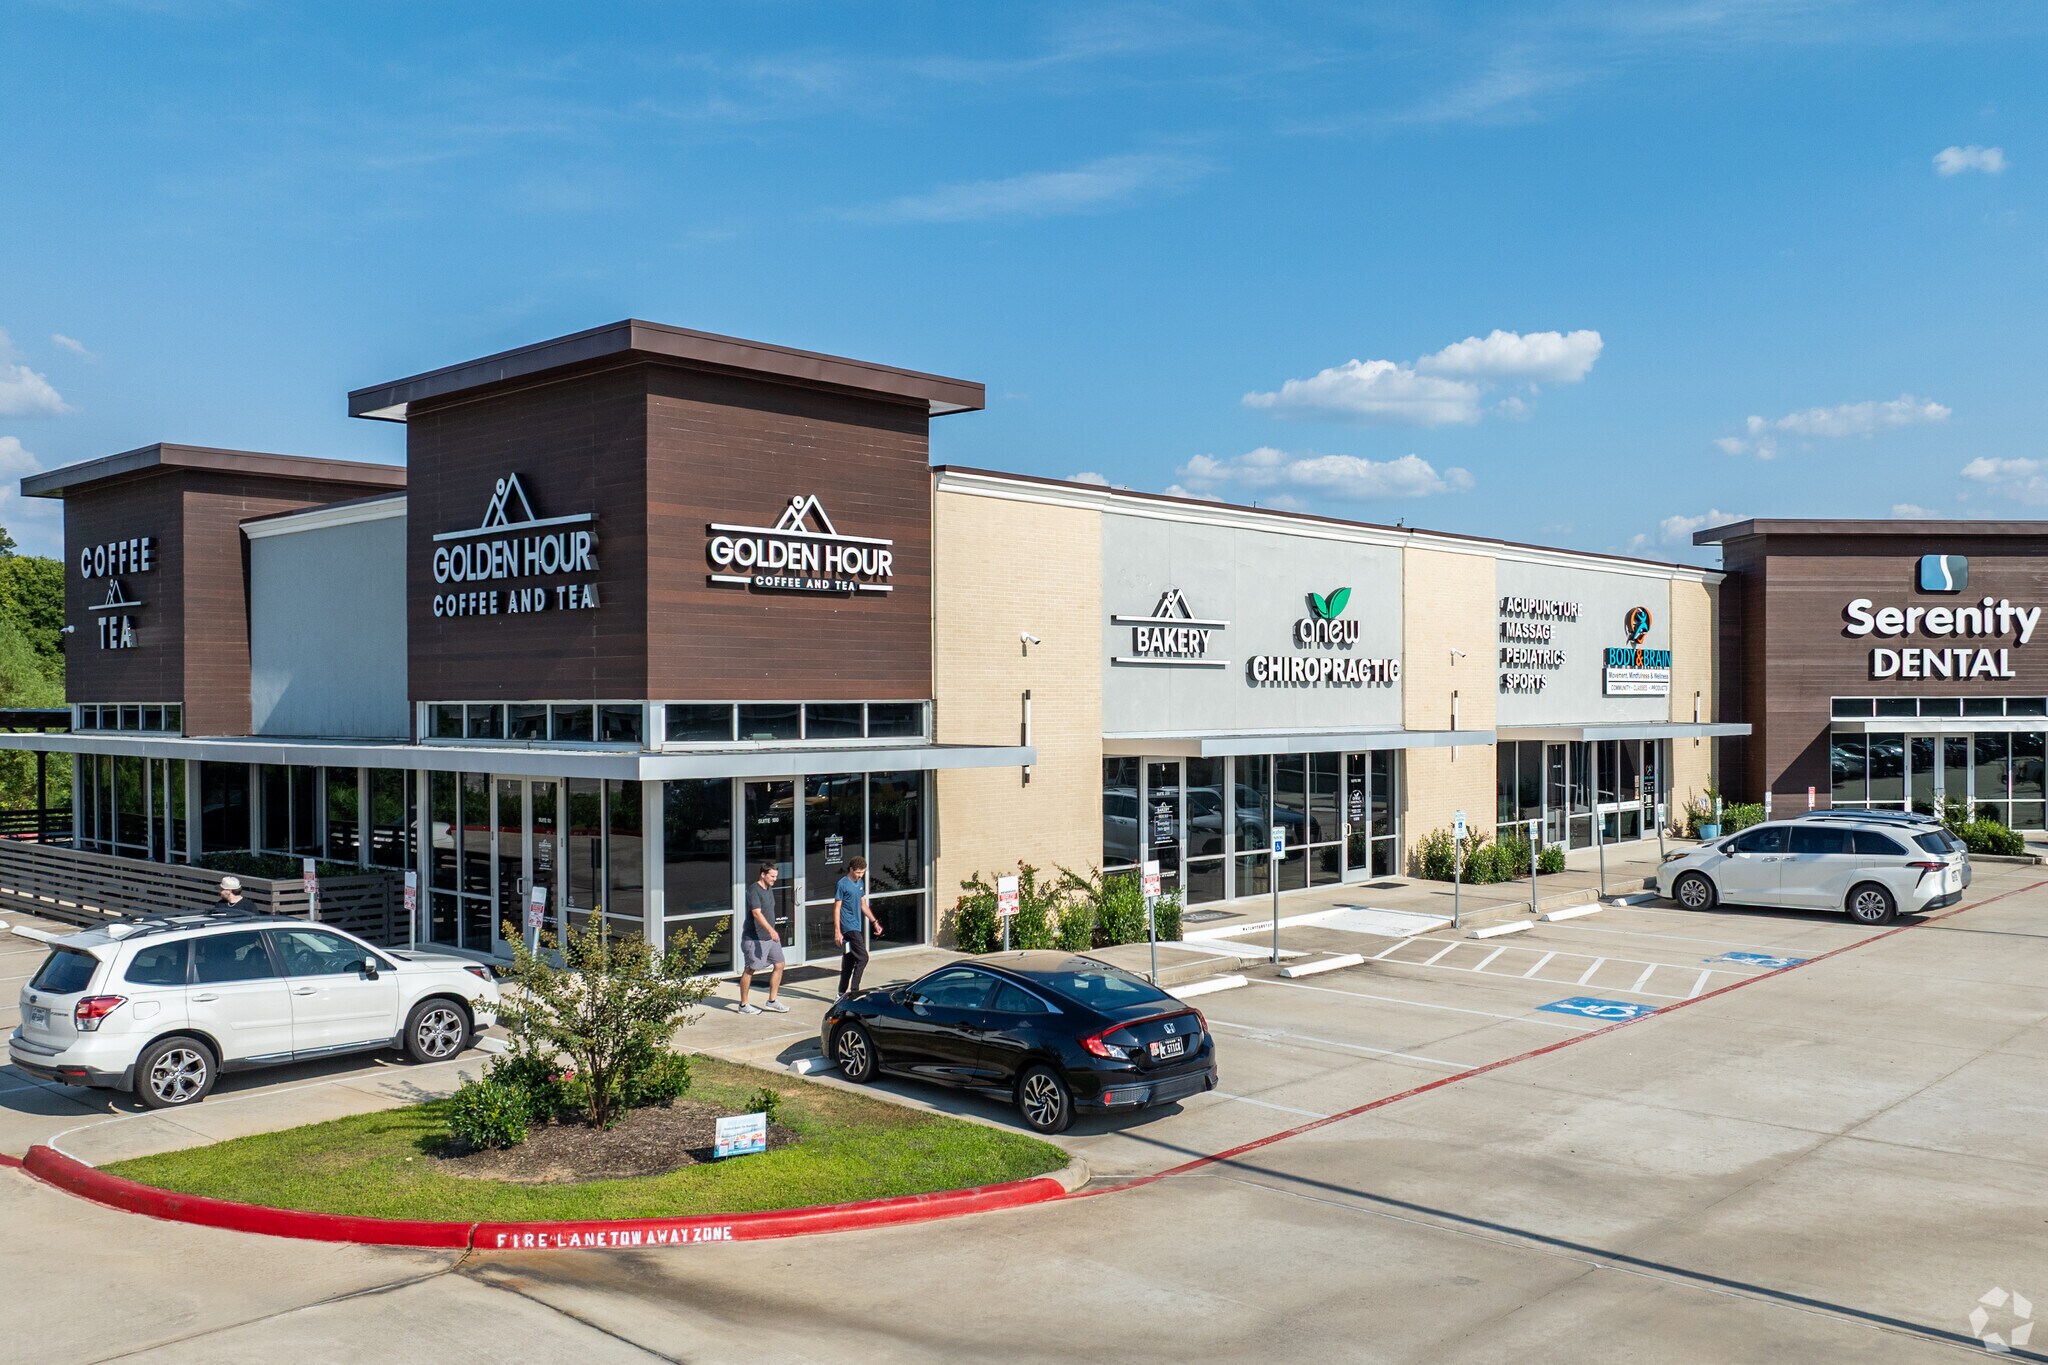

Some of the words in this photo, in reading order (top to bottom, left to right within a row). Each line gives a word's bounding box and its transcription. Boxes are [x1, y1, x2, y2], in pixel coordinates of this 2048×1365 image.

[81, 537, 149, 579] COFFEE
[433, 539, 518, 584] GOLDEN
[524, 531, 592, 576] HOUR
[711, 536, 819, 571] GOLDEN
[825, 545, 893, 577] HOUR
[755, 575, 801, 588] COFFEE
[806, 579, 829, 590] AND
[835, 580, 856, 591] TEA
[433, 590, 498, 618] COFFEE
[508, 587, 546, 614] AND
[556, 584, 594, 610] TEA
[1507, 597, 1583, 617] ACUPUNCTURE
[98, 615, 132, 650] TEA
[1300, 618, 1361, 644] anew
[1506, 622, 1556, 639] MASSAGE
[1847, 597, 2042, 644] Serenity
[1137, 626, 1212, 653] BAKERY
[1253, 655, 1401, 682] CHIROPRACTIC
[1506, 648, 1567, 665] PEDIATRICS
[1874, 648, 2016, 677] DENTAL
[1506, 673, 1547, 689] SPORTS
[496, 1233, 548, 1248] FIRE
[557, 1232, 606, 1247] LANE
[610, 1230, 642, 1246] TOW
[646, 1228, 688, 1244] AWAY
[693, 1226, 733, 1241] ZONE
